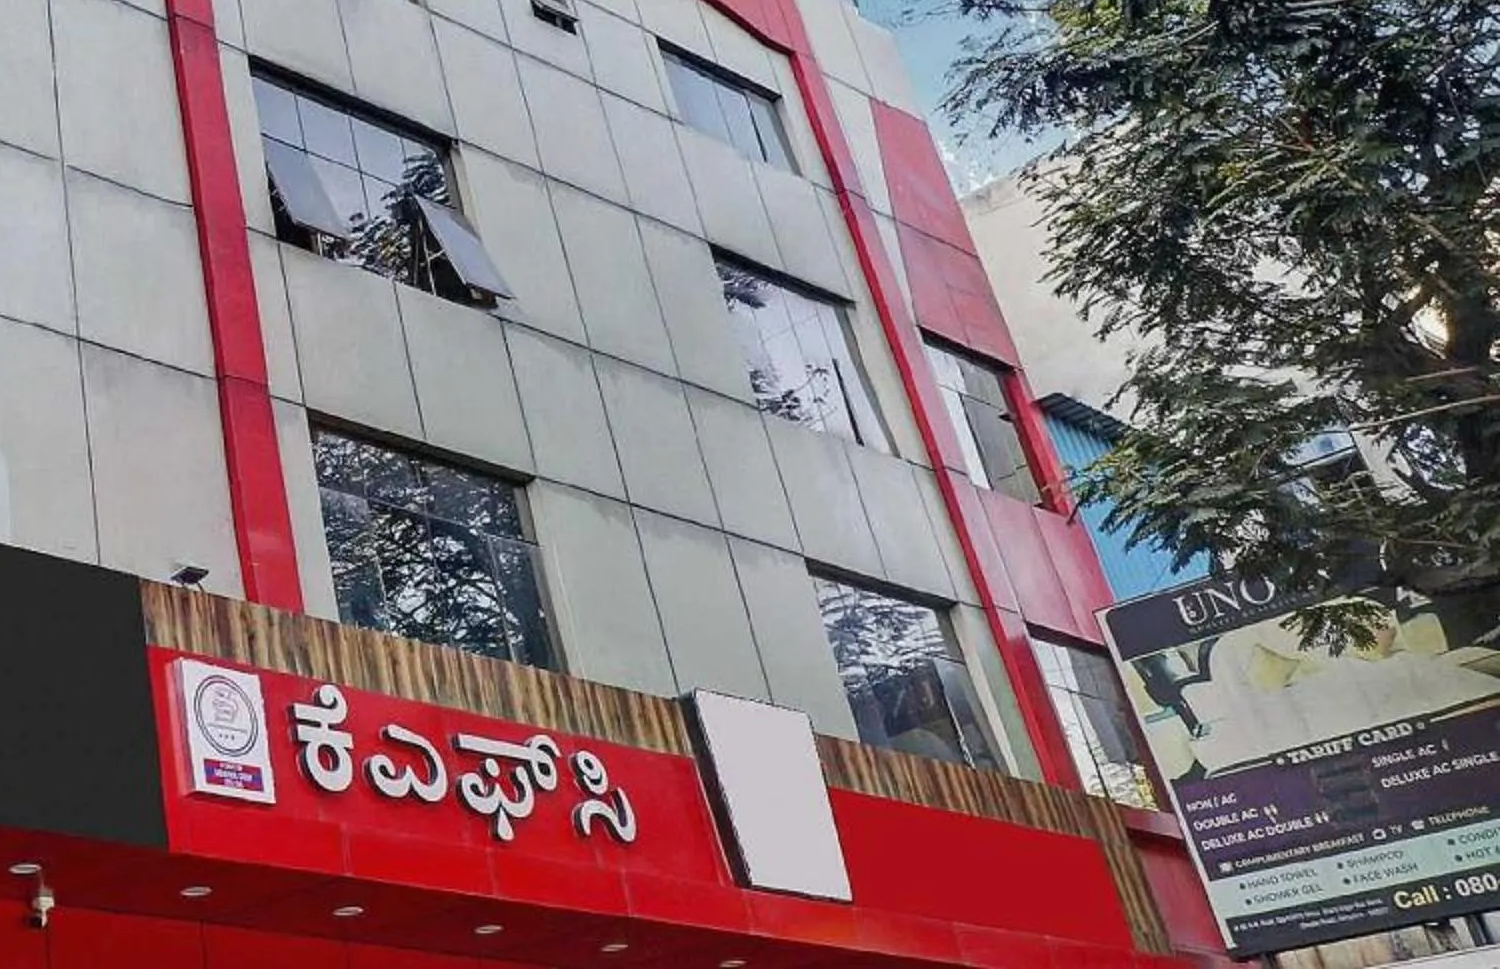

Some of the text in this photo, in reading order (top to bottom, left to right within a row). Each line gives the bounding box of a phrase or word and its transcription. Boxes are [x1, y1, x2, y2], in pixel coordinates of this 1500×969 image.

[1172, 576, 1275, 626] UNO
[1286, 722, 1414, 764] TARIFF CARD
[1371, 743, 1438, 768] SINGLE AC
[1380, 751, 1500, 788] DELUXE AC SINGLE
[1185, 798, 1213, 812] NON
[1221, 792, 1237, 806] AC
[1193, 808, 1259, 832] DOUBLE AC
[1427, 805, 1491, 826] TELEPHONE
[1201, 816, 1314, 851] DELUXE AC DOUBLE
[1311, 832, 1365, 853] BREAKFAST
[1457, 827, 1500, 844] CONDI
[1346, 850, 1404, 869] SHAMPOO
[1353, 862, 1419, 884] FACE WASH
[1393, 884, 1440, 910] Call
[1454, 872, 1500, 897] 080
